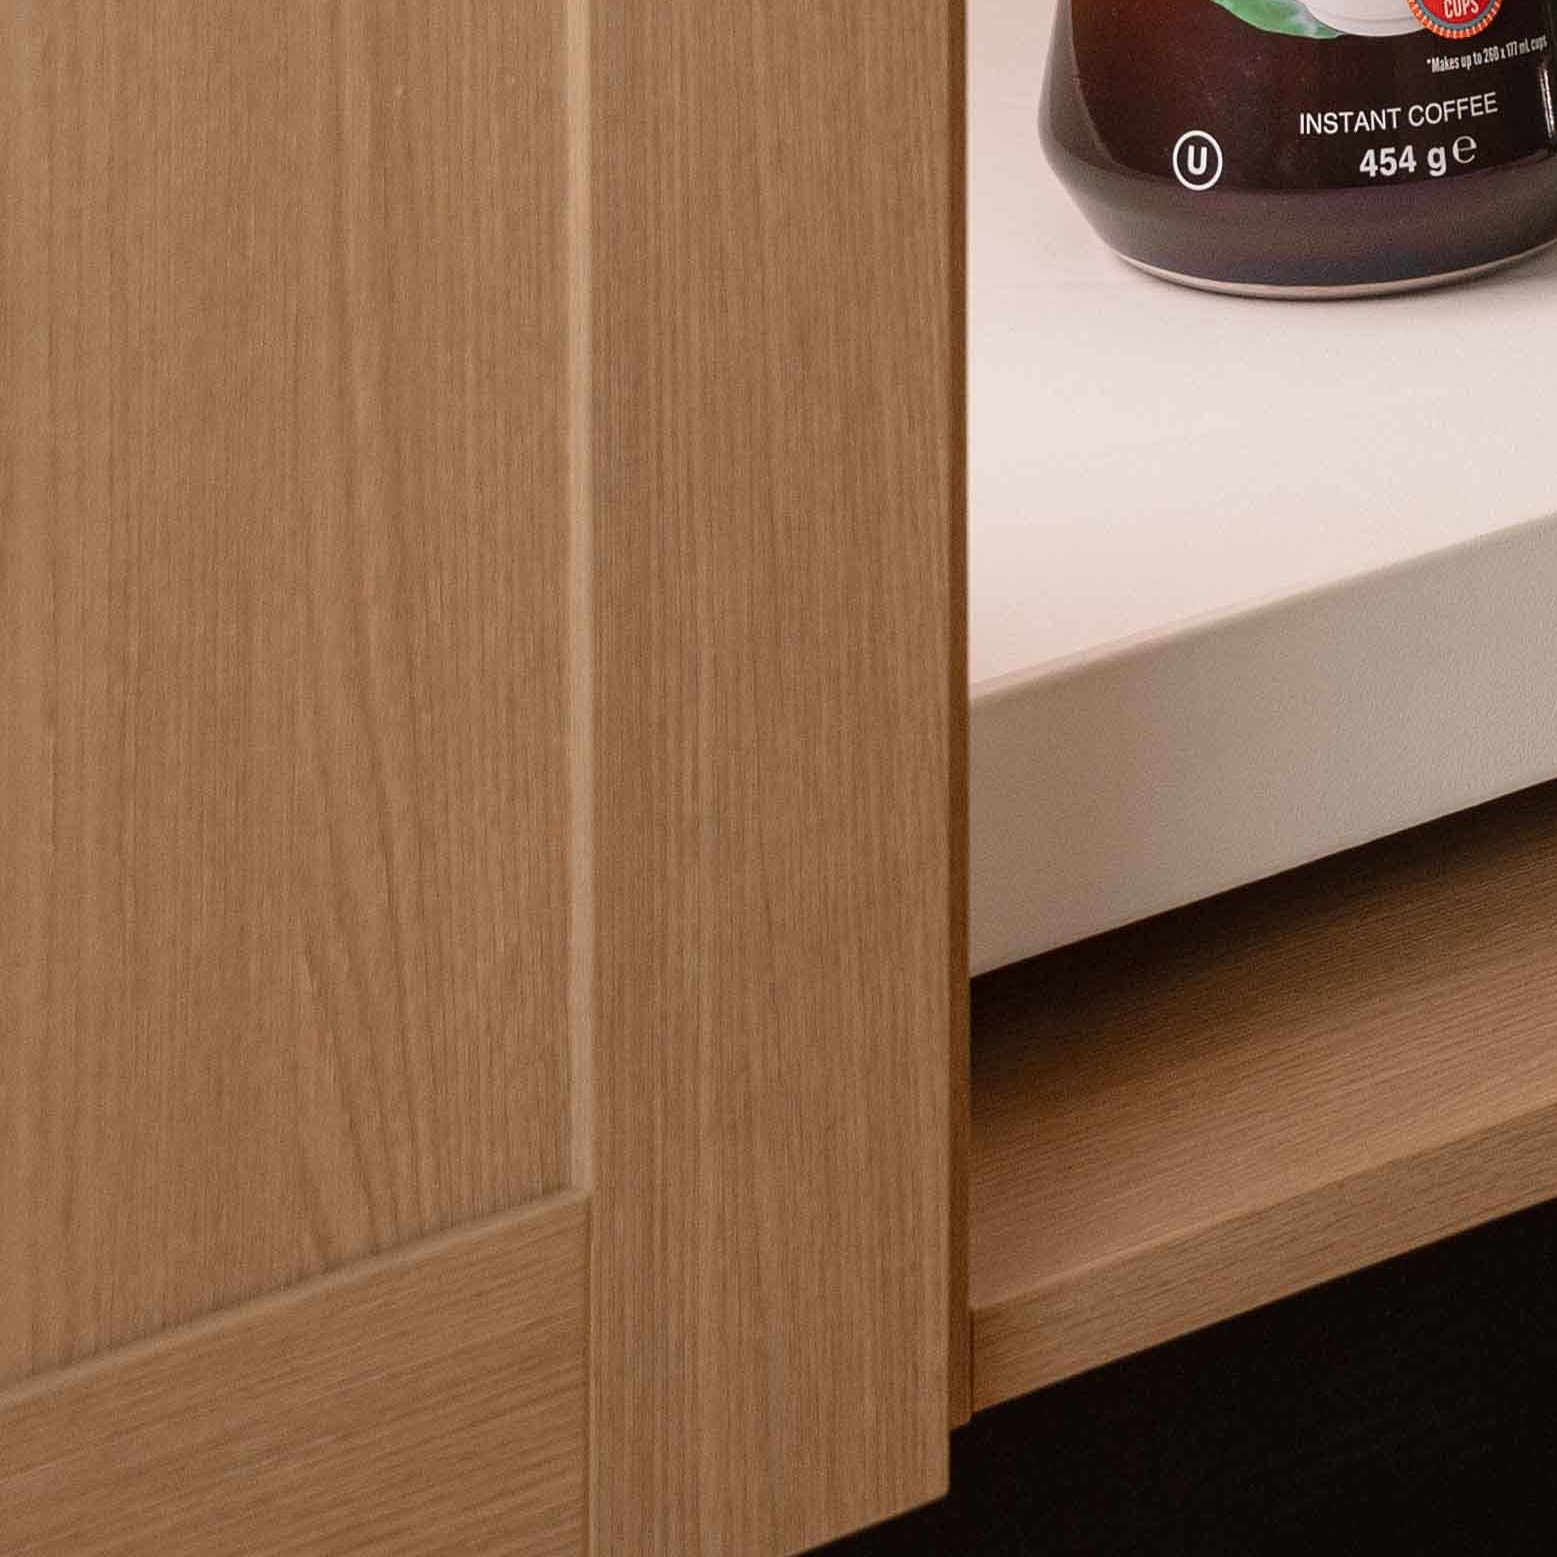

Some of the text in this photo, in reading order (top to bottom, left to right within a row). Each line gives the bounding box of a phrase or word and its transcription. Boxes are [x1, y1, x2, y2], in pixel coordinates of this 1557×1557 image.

[1460, 53, 1473, 71] up
[1472, 51, 1483, 66] to
[1500, 47, 1507, 60] x
[1506, 39, 1518, 58] 177
[1530, 34, 1549, 52] cups
[1299, 91, 1499, 136] INSTANT COFFEE
[1359, 144, 1418, 178] 454
[1426, 148, 1448, 178] g
